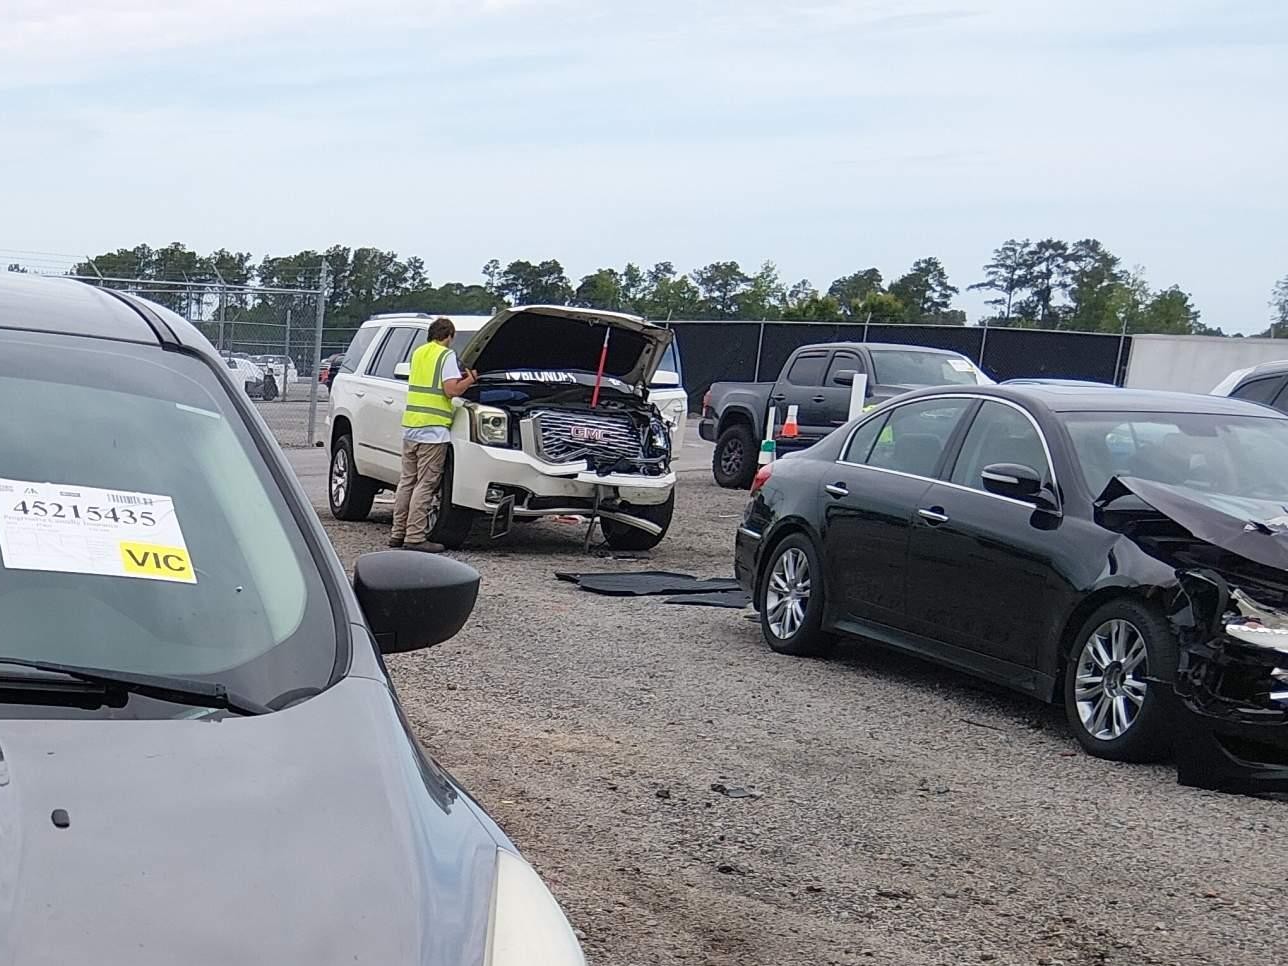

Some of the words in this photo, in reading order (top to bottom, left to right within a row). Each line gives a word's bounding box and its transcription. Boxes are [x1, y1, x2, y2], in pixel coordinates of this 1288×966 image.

[571, 425, 612, 441] GMC
[13, 500, 156, 527] 45215435
[125, 548, 186, 572] VIC
